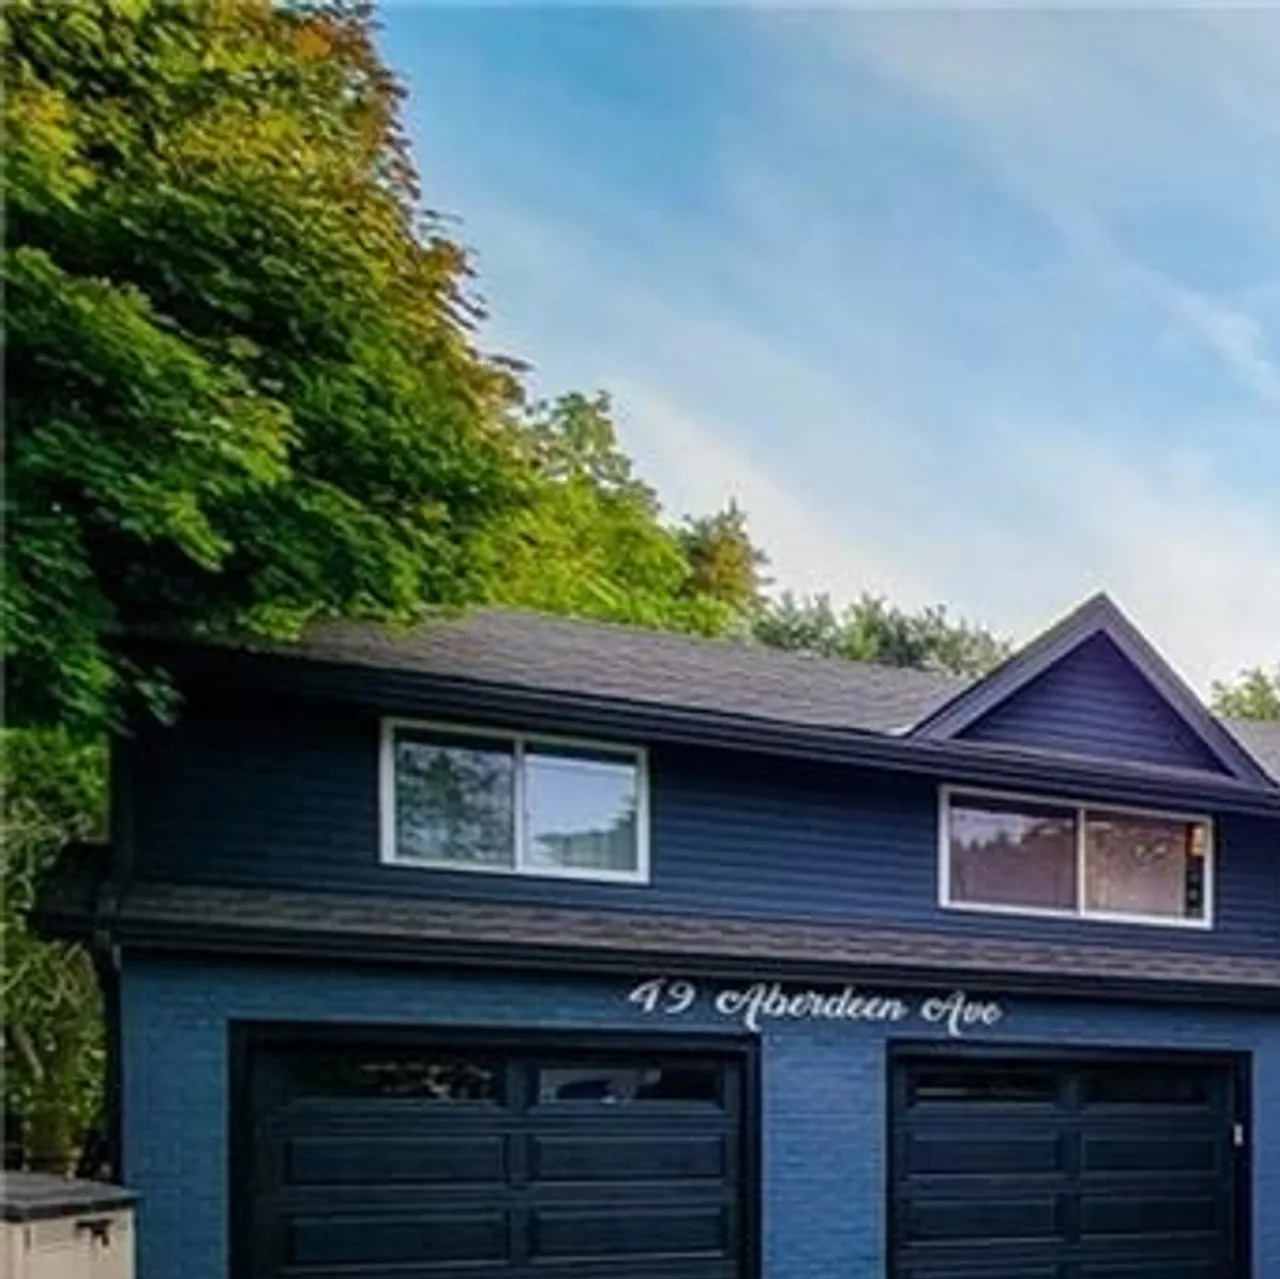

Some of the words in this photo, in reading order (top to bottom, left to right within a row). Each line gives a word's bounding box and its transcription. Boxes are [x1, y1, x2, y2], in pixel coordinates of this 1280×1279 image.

[629, 978, 695, 1013] 49
[715, 983, 904, 1032] Aberdeen
[921, 990, 1002, 1036] Ave
